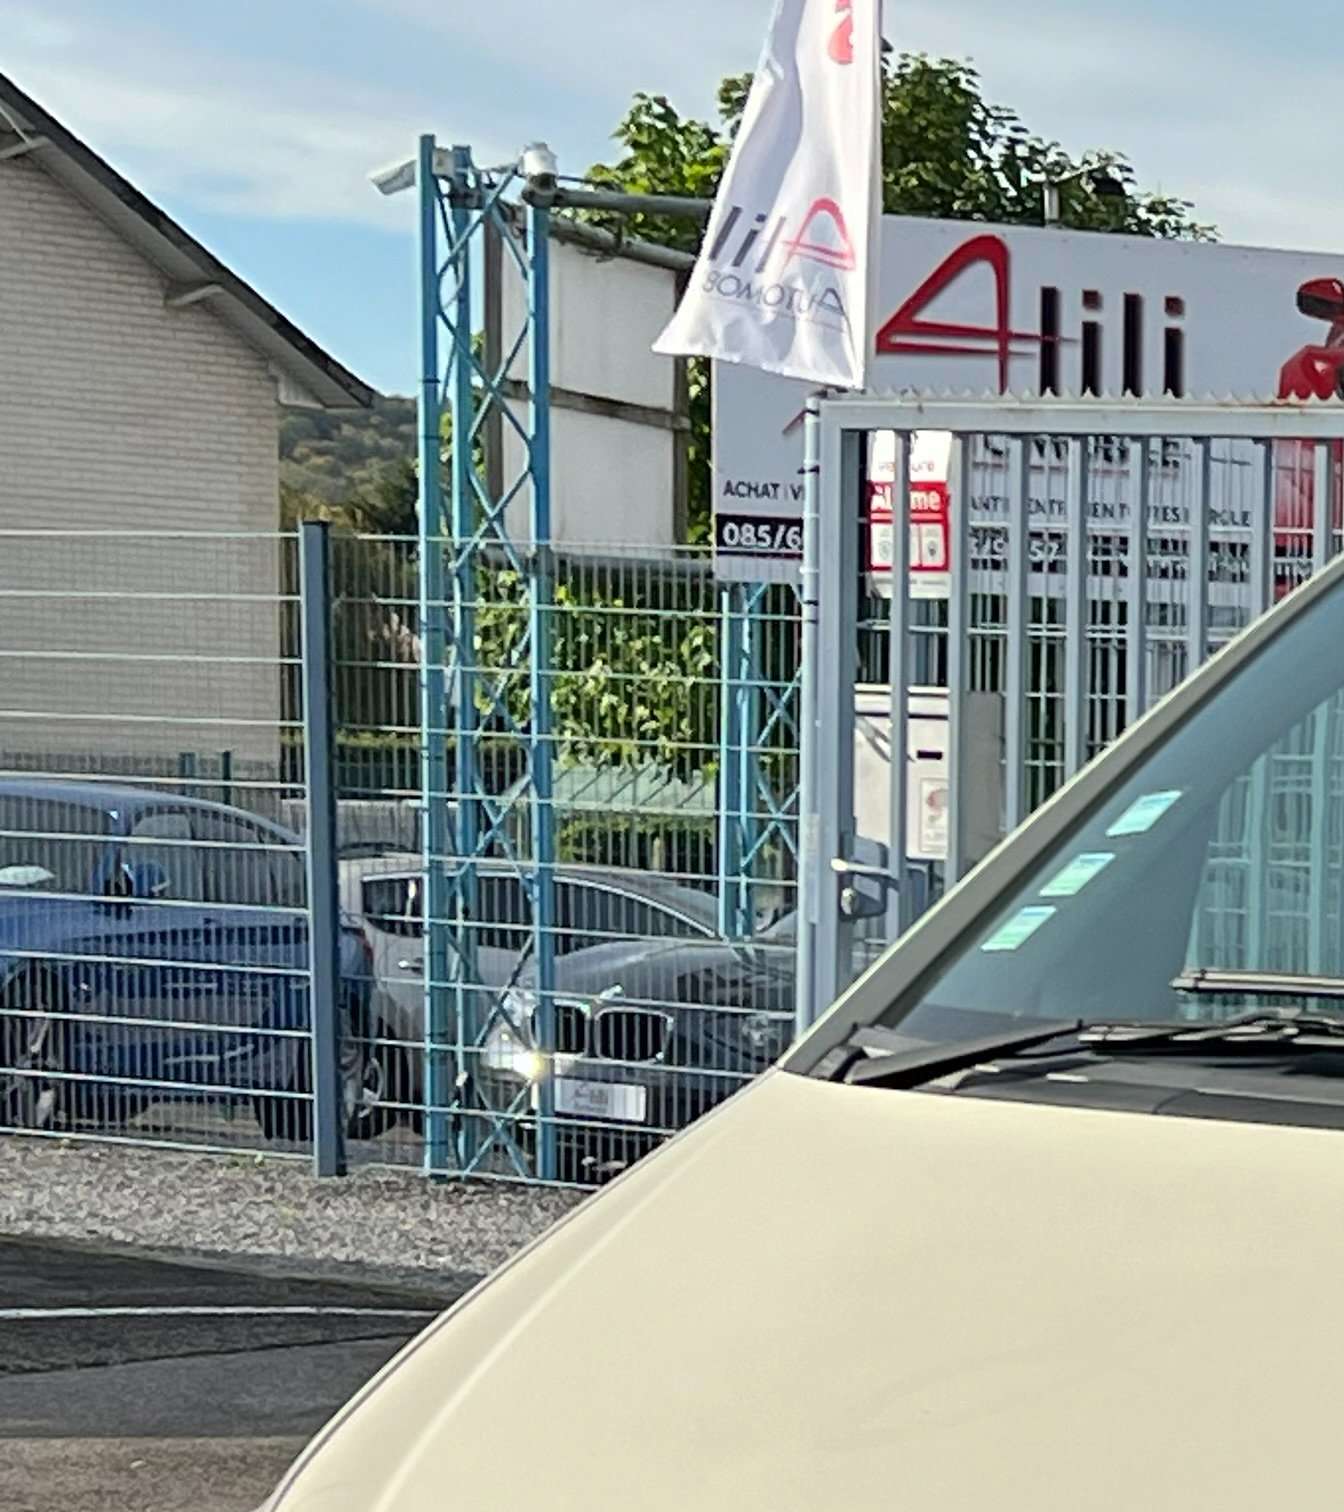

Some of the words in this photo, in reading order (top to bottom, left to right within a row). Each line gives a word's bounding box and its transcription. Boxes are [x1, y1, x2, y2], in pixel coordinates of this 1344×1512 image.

[875, 234, 1188, 398] Alili
[723, 481, 780, 500] ACHAT
[722, 521, 803, 549] 085/6
